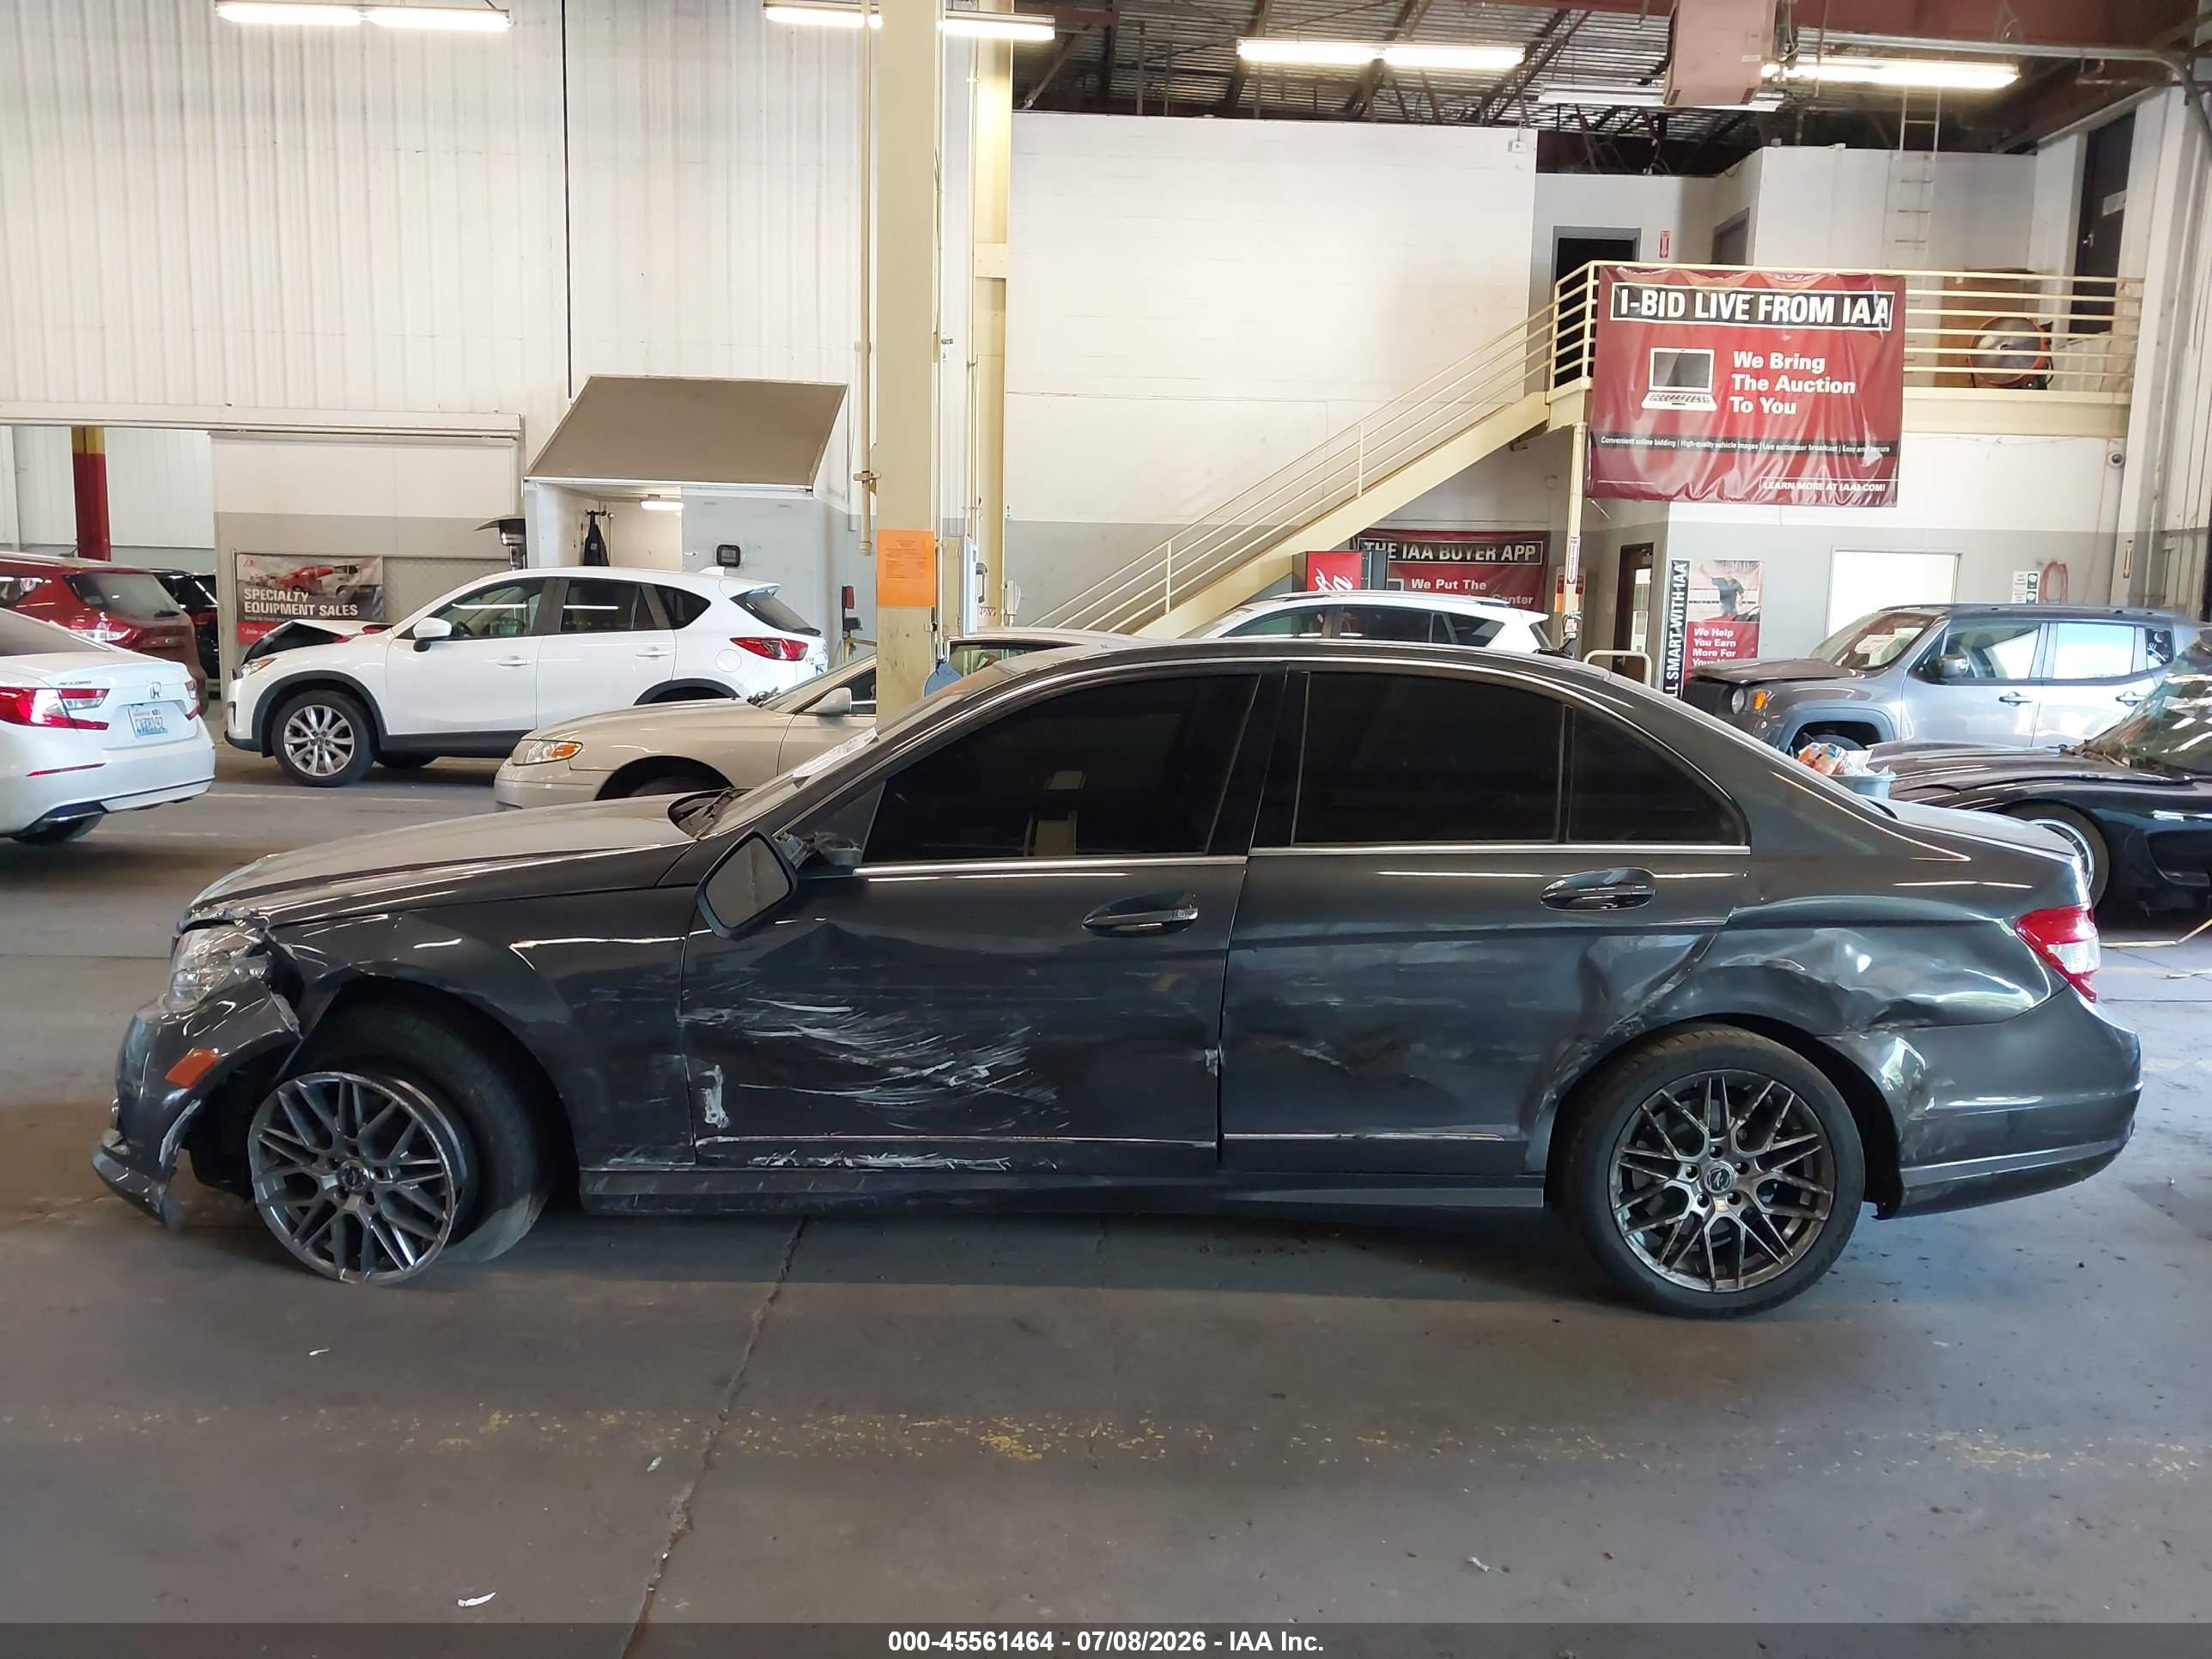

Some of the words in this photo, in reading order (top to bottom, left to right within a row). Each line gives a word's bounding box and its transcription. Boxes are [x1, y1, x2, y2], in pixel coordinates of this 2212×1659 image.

[1620, 288, 1686, 319] I-BID
[1694, 292, 1751, 320] LIVE
[1758, 295, 1834, 324] FROM
[1842, 296, 1888, 325] IAA
[1733, 350, 1764, 369] We
[1769, 352, 1826, 374] Bring
[1731, 374, 1769, 392] The
[1774, 375, 1856, 394] Auction
[1729, 396, 1753, 414] To
[1759, 398, 1796, 416] You
[1601, 435, 1635, 445] Convenient
[1654, 439, 1676, 448] bidding
[1680, 440, 1714, 451] High-quality
[1763, 442, 1775, 451] Live
[1808, 443, 1838, 453] broadcast
[1764, 480, 1794, 490] LEARN
[1797, 481, 1823, 490] MORE
[1826, 483, 1838, 491] AT
[1402, 543, 1433, 560] IAA
[1439, 544, 1496, 561] BUYER
[1500, 544, 1536, 561] APP
[1673, 562, 1686, 587] IAA
[1411, 578, 1431, 589] We
[1436, 578, 1458, 590] Put
[1462, 580, 1486, 590] The
[244, 588, 309, 602] SPECIALTY
[244, 602, 315, 616] EQUIPMENT
[319, 604, 358, 617] SALES
[1669, 591, 1685, 628] WITH
[1693, 628, 1709, 636] We
[1711, 629, 1734, 638] Help
[1693, 638, 1711, 647] You
[1714, 639, 1736, 647] Earn
[1667, 630, 1682, 680] SMART
[1692, 648, 1717, 657] More
